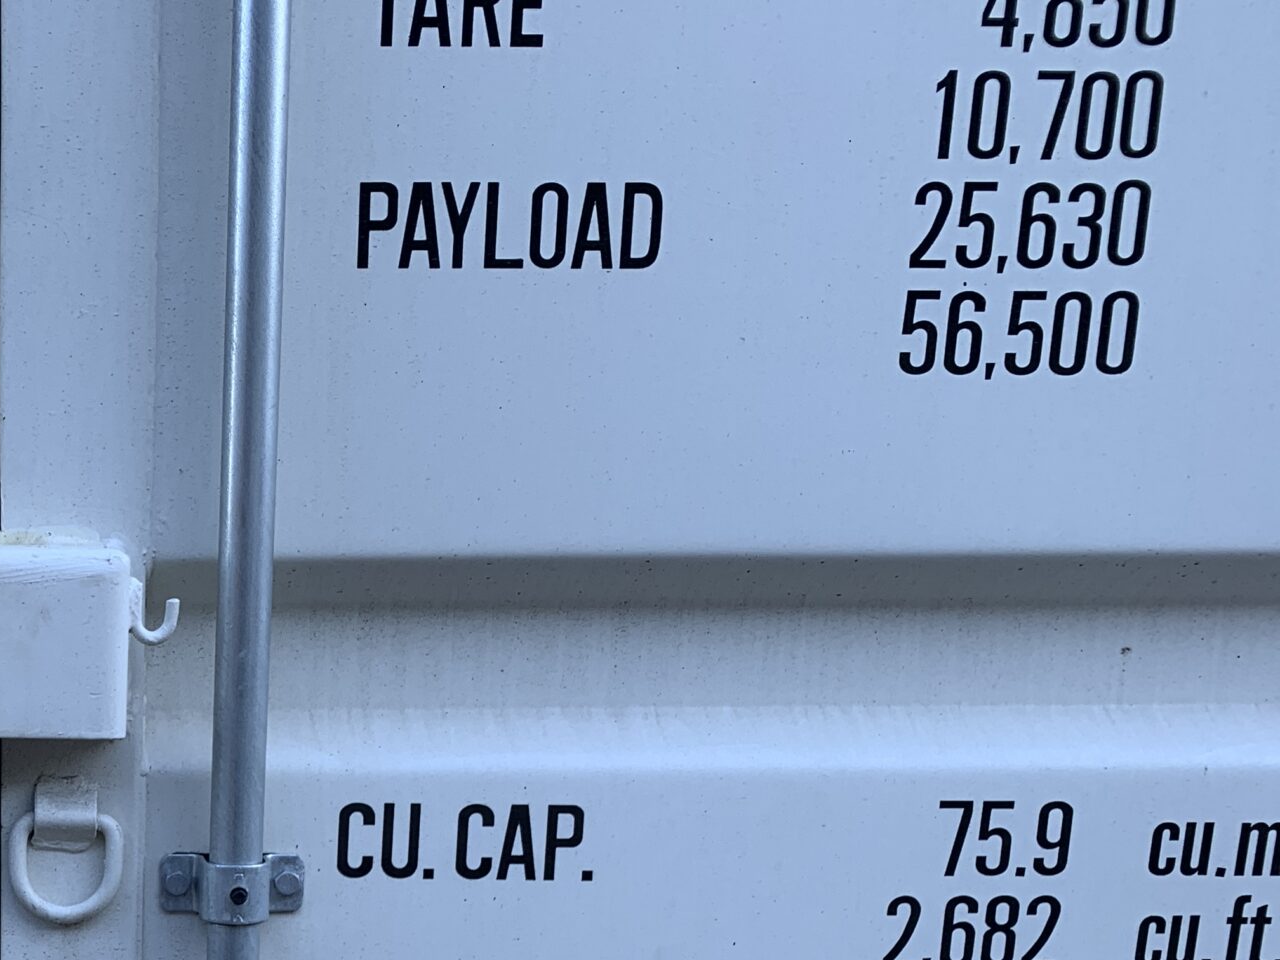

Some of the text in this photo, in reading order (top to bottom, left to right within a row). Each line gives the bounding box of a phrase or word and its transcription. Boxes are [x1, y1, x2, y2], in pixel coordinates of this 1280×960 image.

[934, 70, 1165, 165] 10,700
[356, 180, 1152, 274] PAYLOAD 25,630
[898, 290, 1141, 381] 56,500
[336, 803, 436, 880] CU.
[455, 803, 595, 882] CAP.
[937, 800, 1075, 878] 75.9
